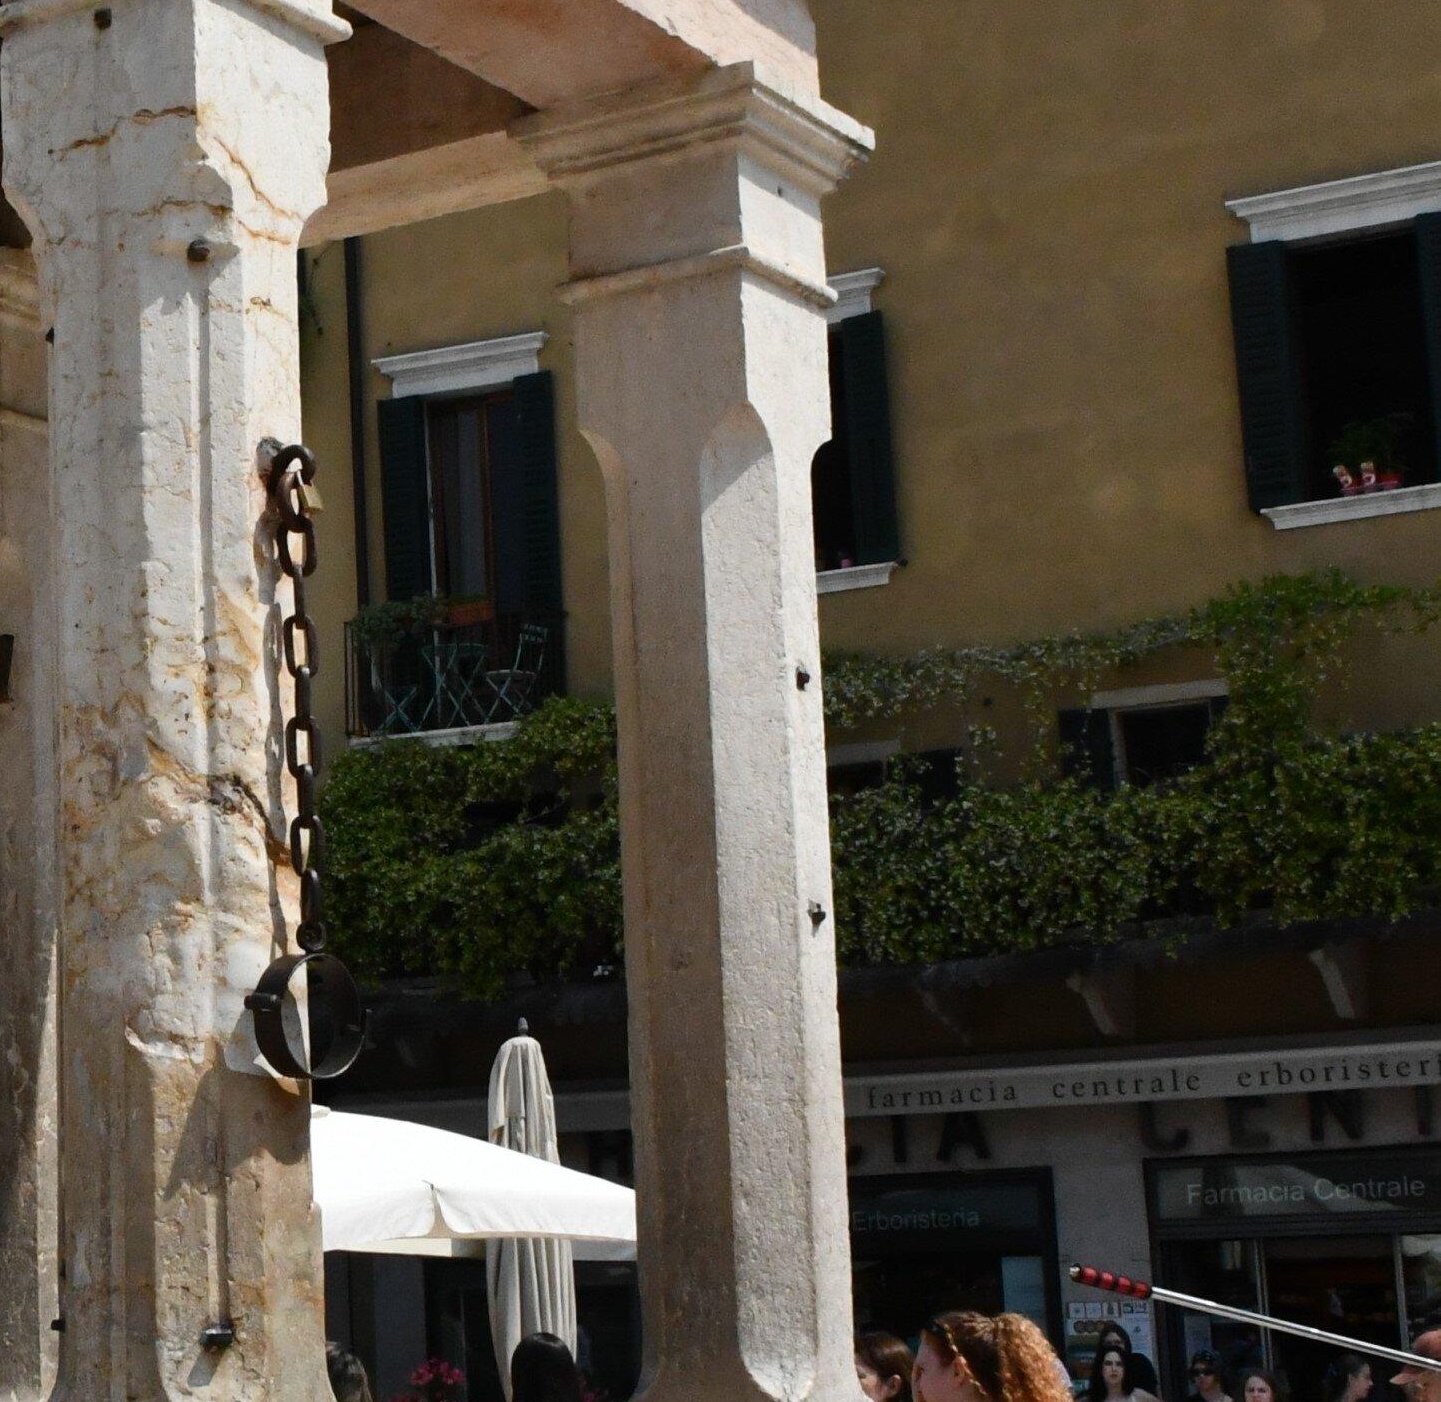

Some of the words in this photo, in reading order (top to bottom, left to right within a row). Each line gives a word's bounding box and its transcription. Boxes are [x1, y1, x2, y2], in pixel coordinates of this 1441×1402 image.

[866, 1079, 1018, 1109] farmacia
[1051, 1068, 1202, 1099] centrale
[1187, 1181, 1306, 1207] Farmacia
[1313, 1175, 1426, 1201] Centrale
[852, 1207, 980, 1233] Erboristeria
